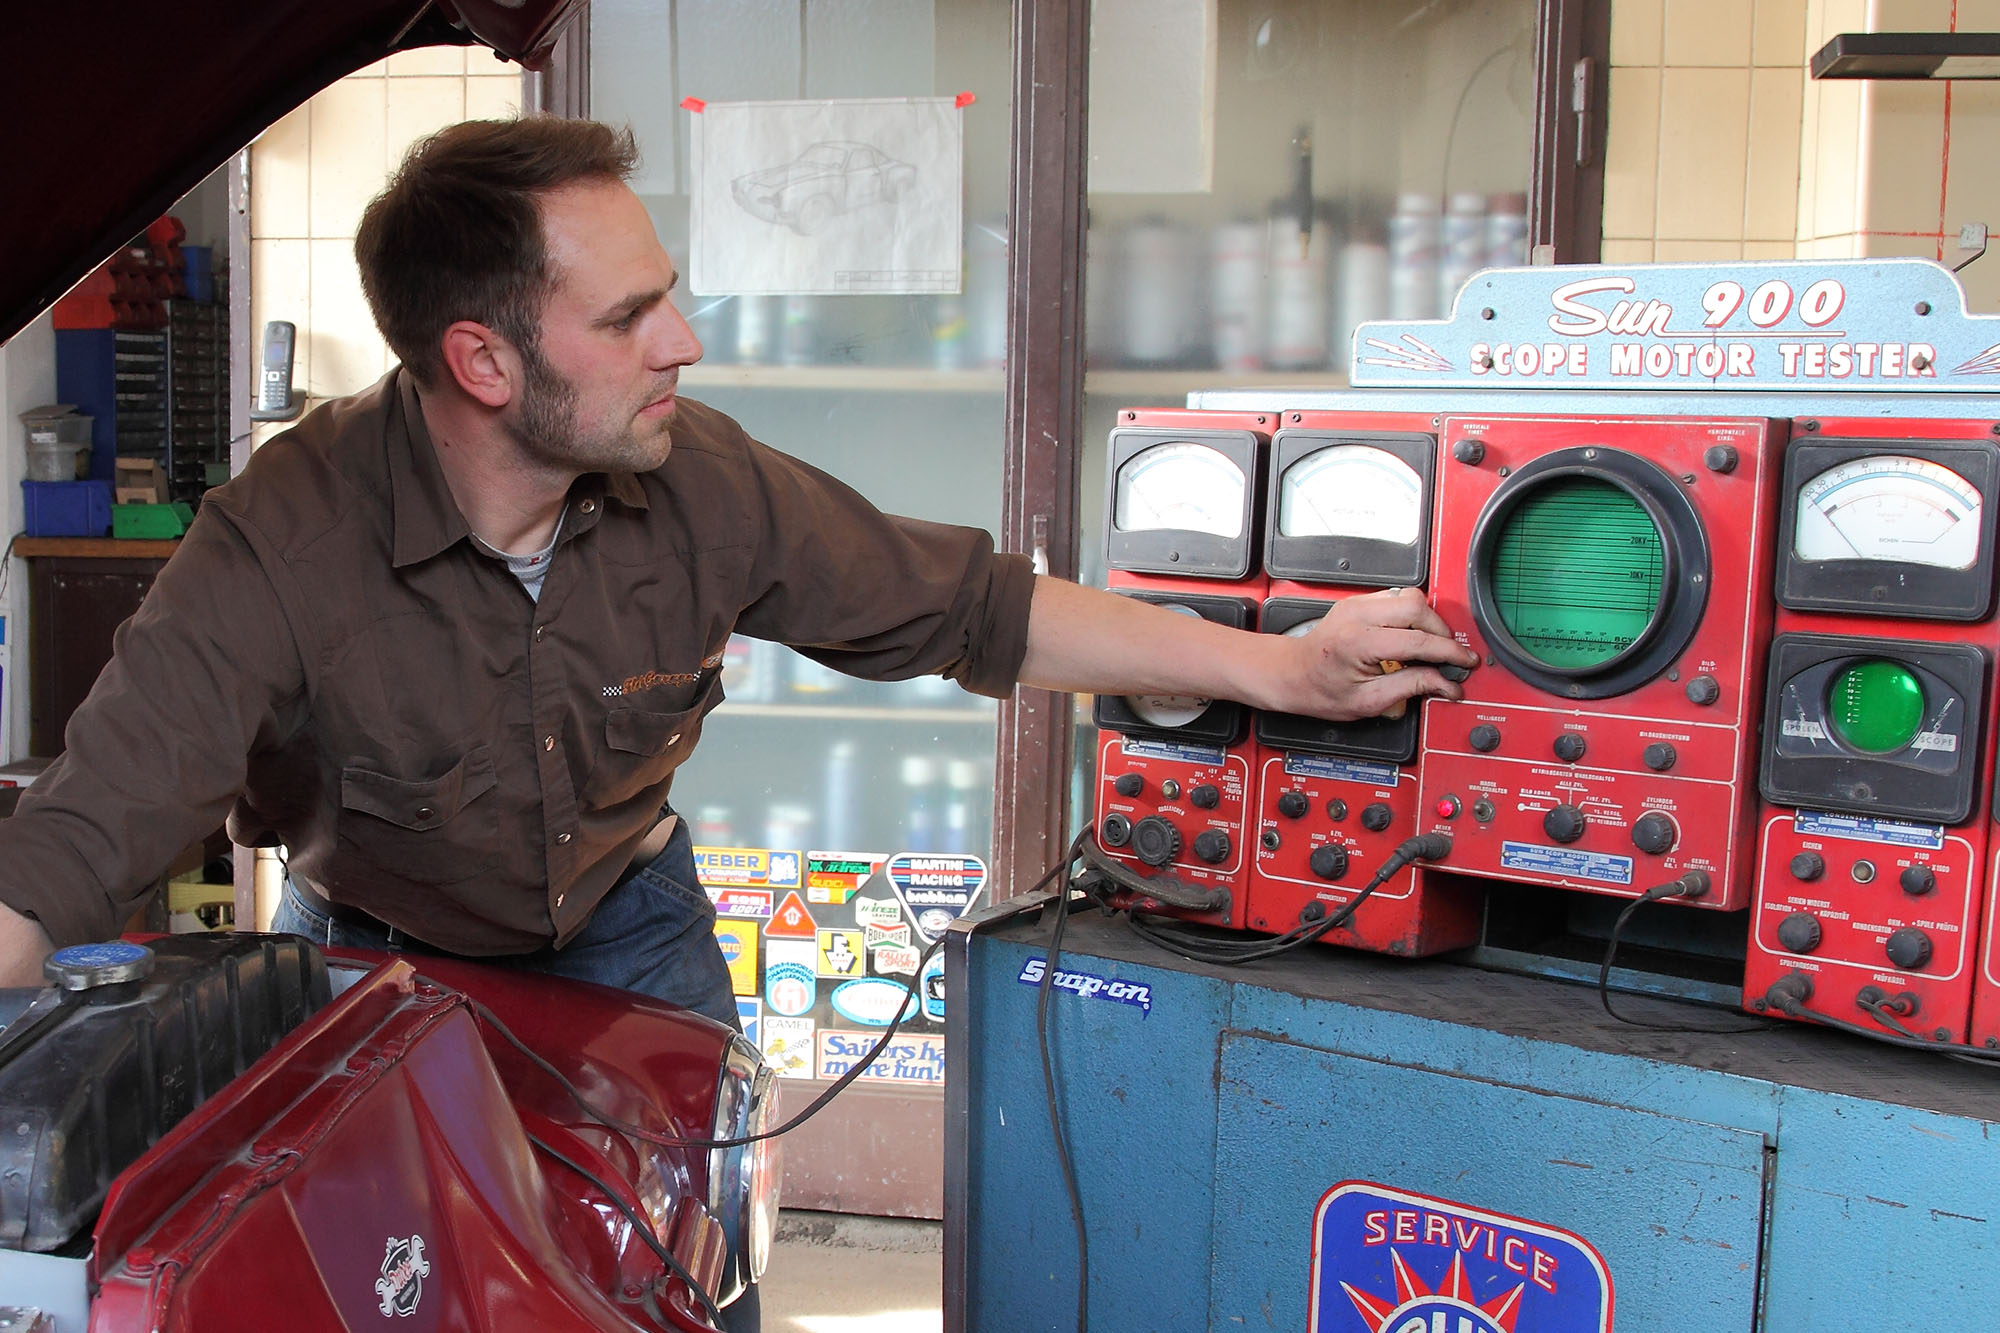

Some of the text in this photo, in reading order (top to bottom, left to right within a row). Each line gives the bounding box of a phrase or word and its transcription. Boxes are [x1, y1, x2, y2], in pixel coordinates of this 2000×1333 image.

[1547, 277, 1848, 337] Sun 900
[1469, 342, 1938, 379] SCOPE MOTOR TESTER
[1920, 736, 1955, 746] SCOPE
[1803, 821, 1827, 832] Sun
[695, 853, 759, 868] WEBER
[910, 858, 964, 871] MARTINI
[910, 874, 964, 886] RACING
[728, 895, 766, 905] KONI
[905, 889, 967, 904] brabham
[729, 904, 766, 915] sport
[877, 951, 912, 960] RALLYE
[884, 959, 916, 968] SPORT
[766, 1018, 811, 1031] CAMEL
[825, 1035, 917, 1058] Sailors
[824, 1059, 944, 1080] mre fun!
[1363, 1210, 1559, 1294] SERVICE
